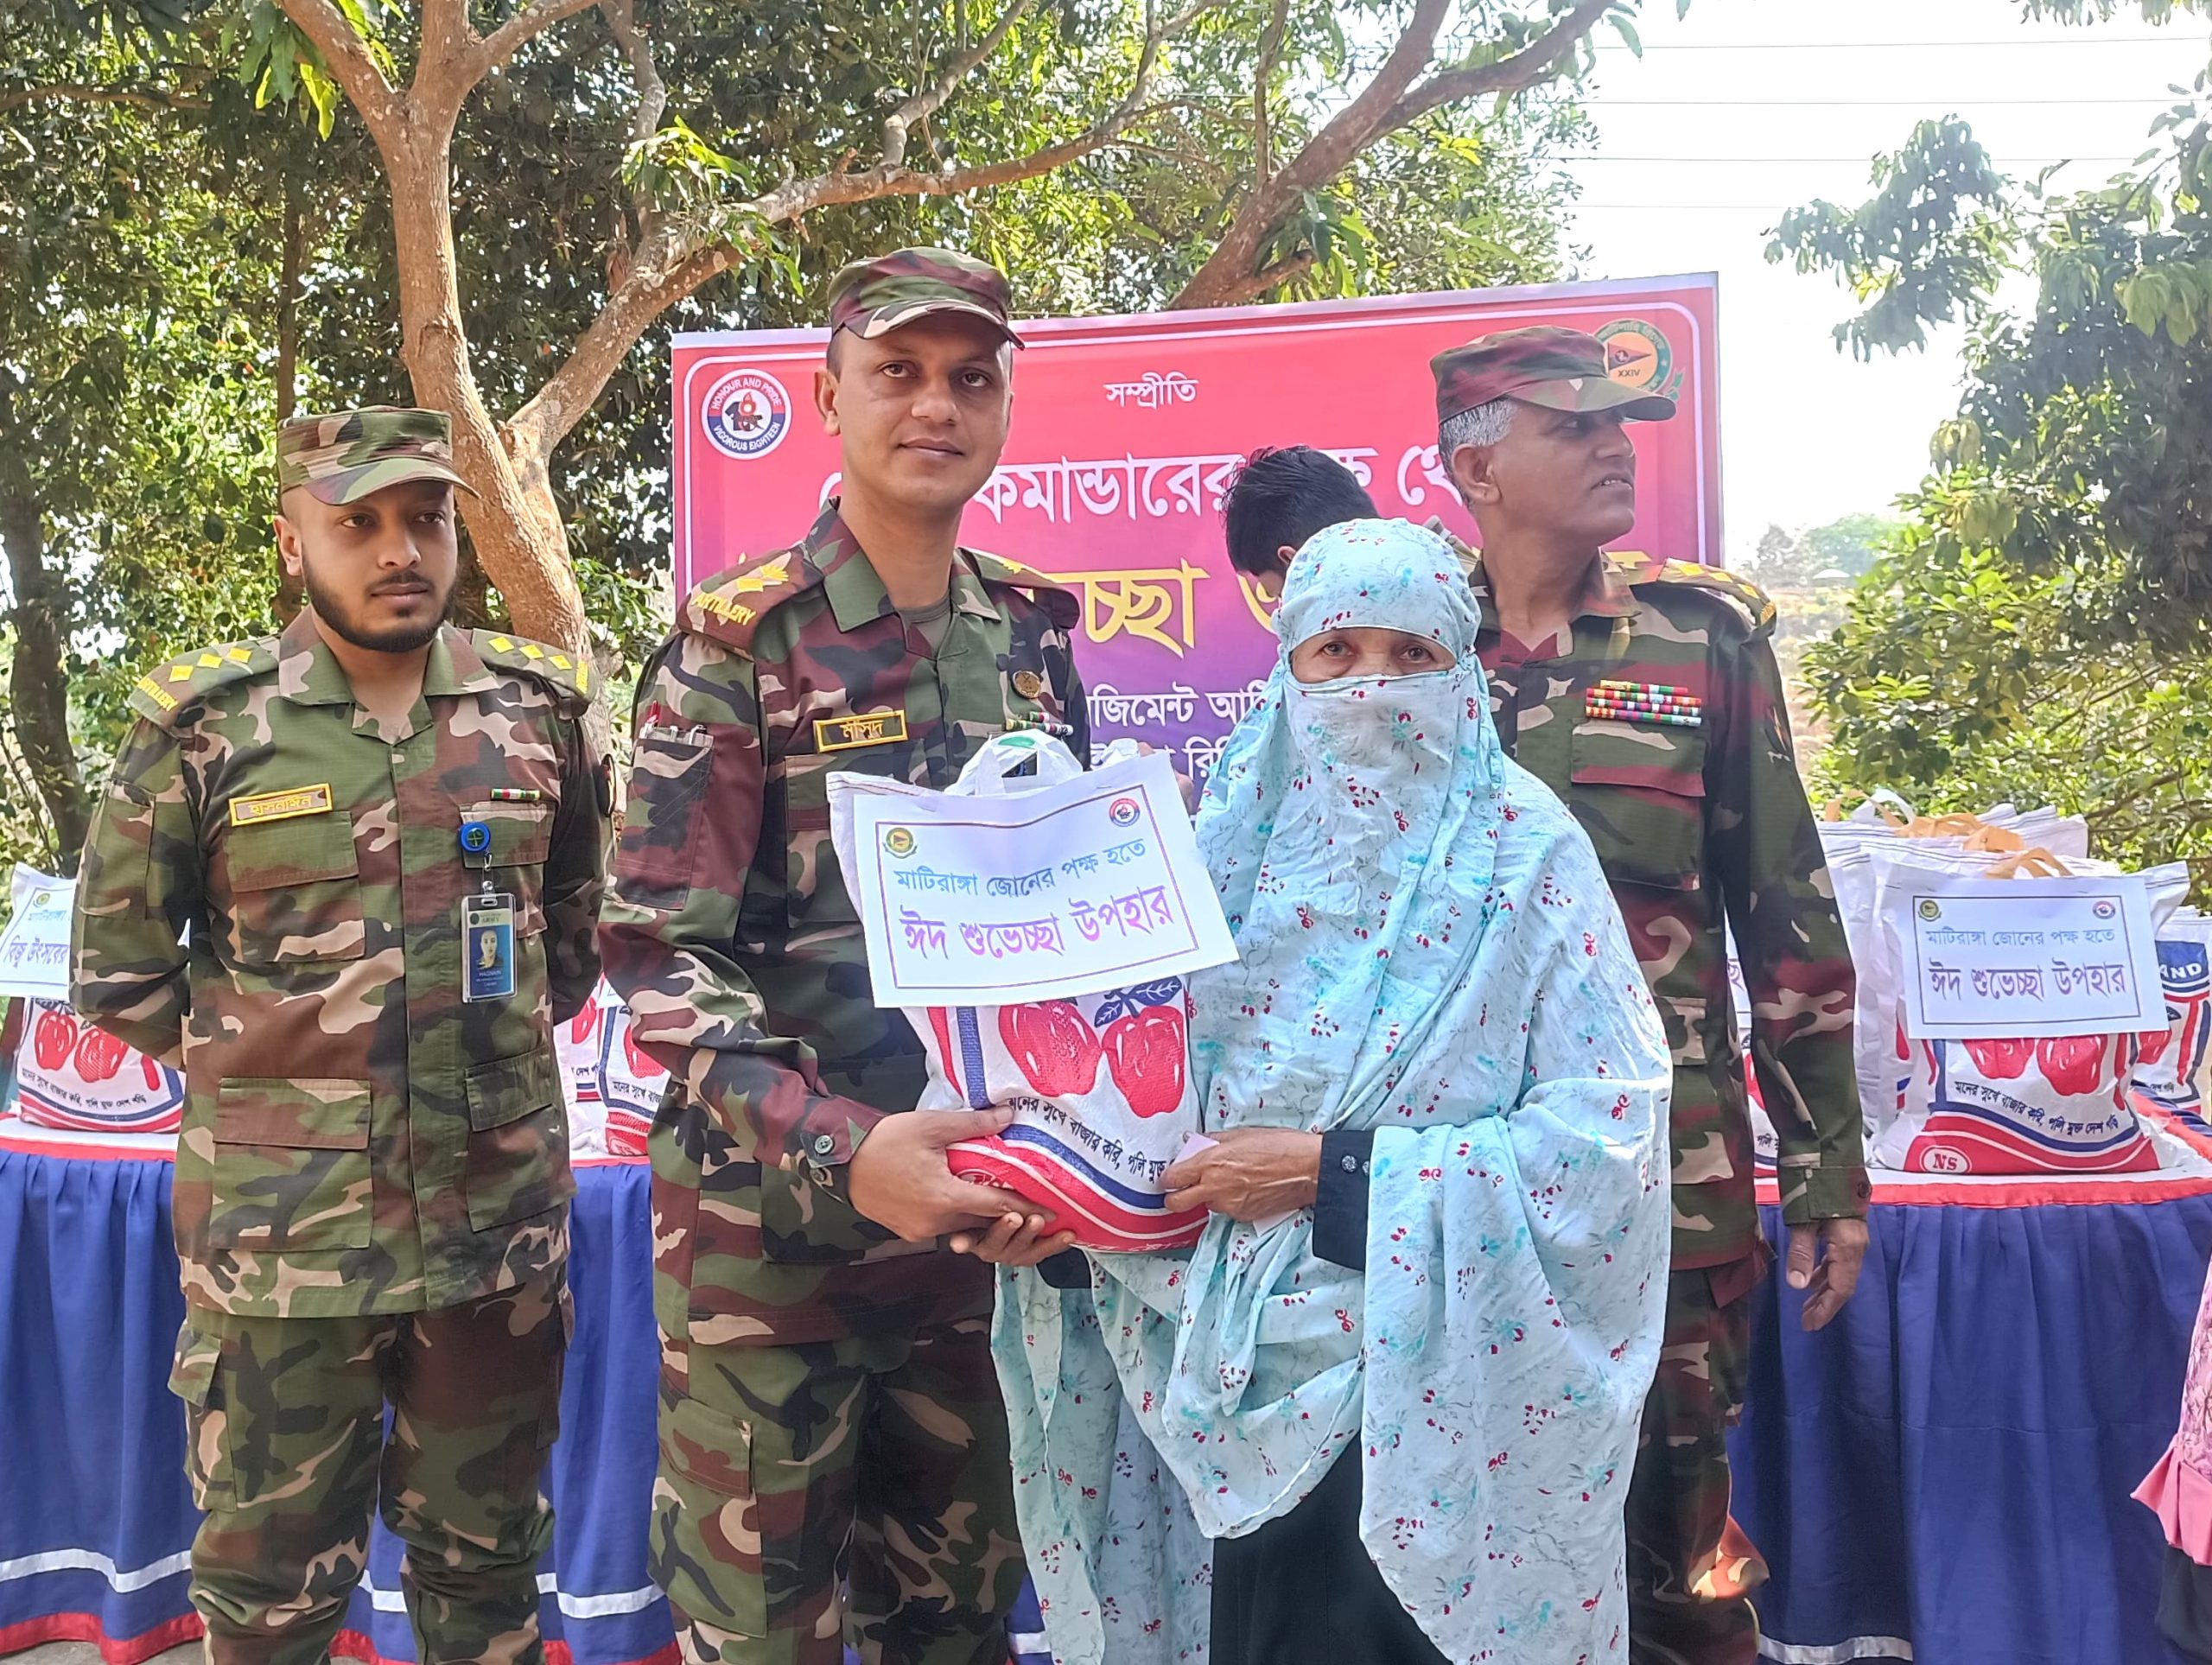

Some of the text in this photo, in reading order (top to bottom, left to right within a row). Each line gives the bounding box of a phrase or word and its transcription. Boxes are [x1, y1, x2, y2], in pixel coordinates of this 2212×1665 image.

[711, 377, 783, 410] HONOUR AND PRIDE
[1103, 370, 1200, 410] সম্প্রীতি
[714, 422, 781, 451] VIGOROUS EIGHTEEN
[691, 592, 757, 626] ARTILLERY
[893, 838, 1147, 898] মাটিরাঙ্গা জোনের পক্ষ হতে
[899, 886, 1174, 960] ঈদ শুভেচ্ছা উপহার
[1925, 926, 2115, 946] মাটিরাঙ্গা জোনের পক্ষ হতে
[1929, 956, 2126, 1002] ঈদ শুভেচ্ছা উপহার
[2159, 963, 2202, 979] AND
[1933, 1153, 1957, 1171] NS
